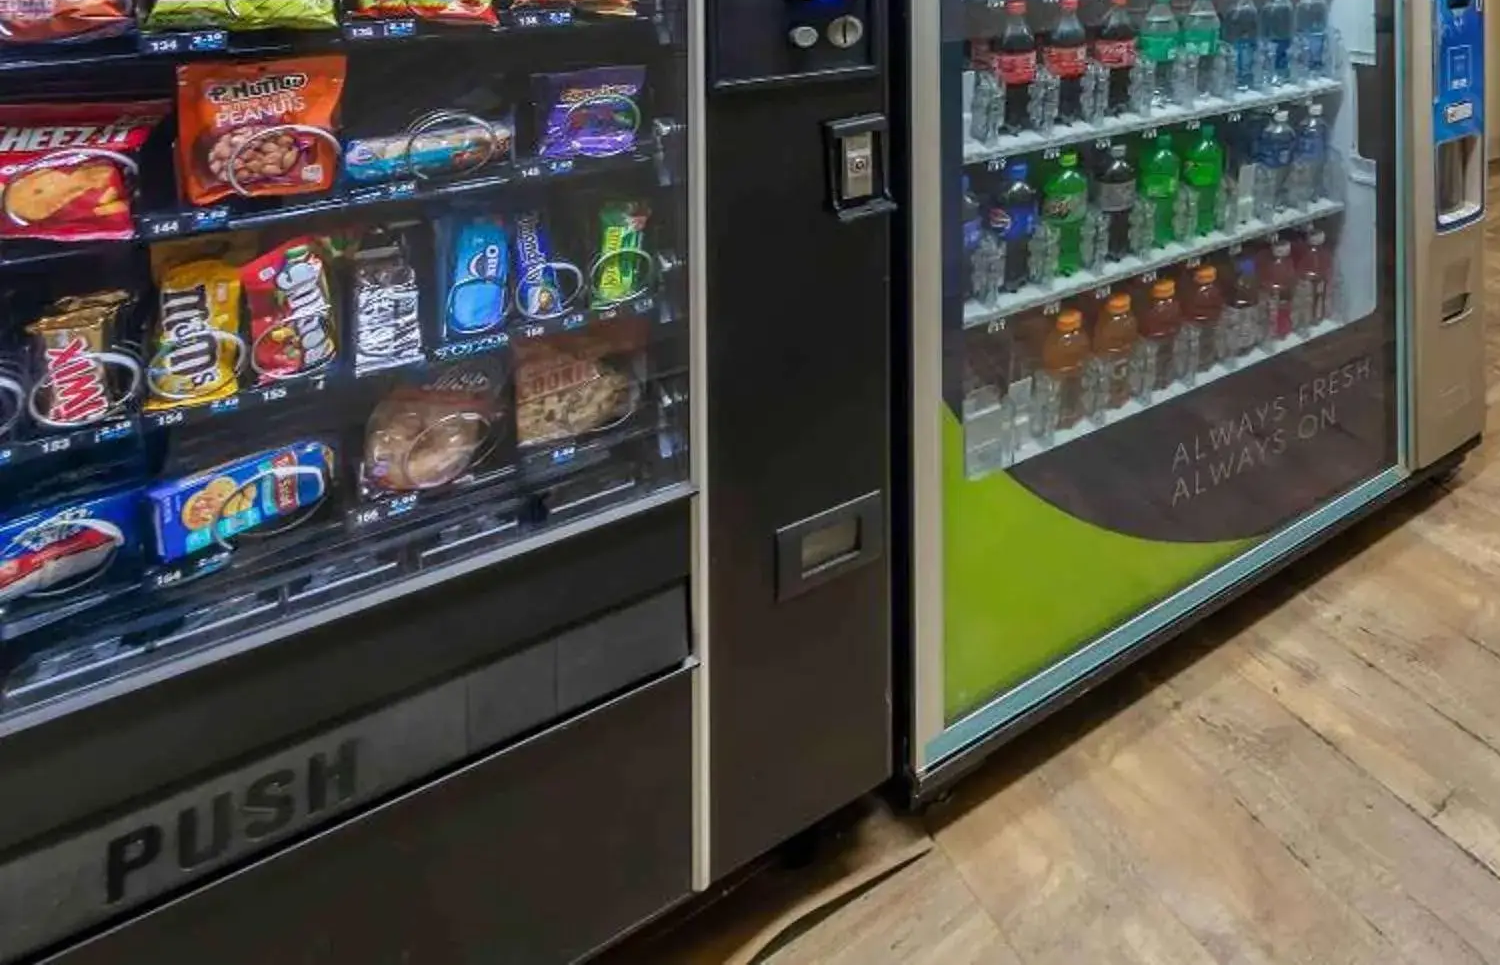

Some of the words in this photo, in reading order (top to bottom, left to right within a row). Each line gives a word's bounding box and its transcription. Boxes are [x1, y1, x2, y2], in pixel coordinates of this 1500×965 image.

[215, 98, 306, 128] PEANUTS
[1172, 396, 1287, 472] ALWAYS
[1299, 357, 1371, 408] FRESH
[1172, 429, 1287, 508] ALWAYS
[1298, 404, 1338, 439] ON
[106, 735, 357, 906] PUSH
